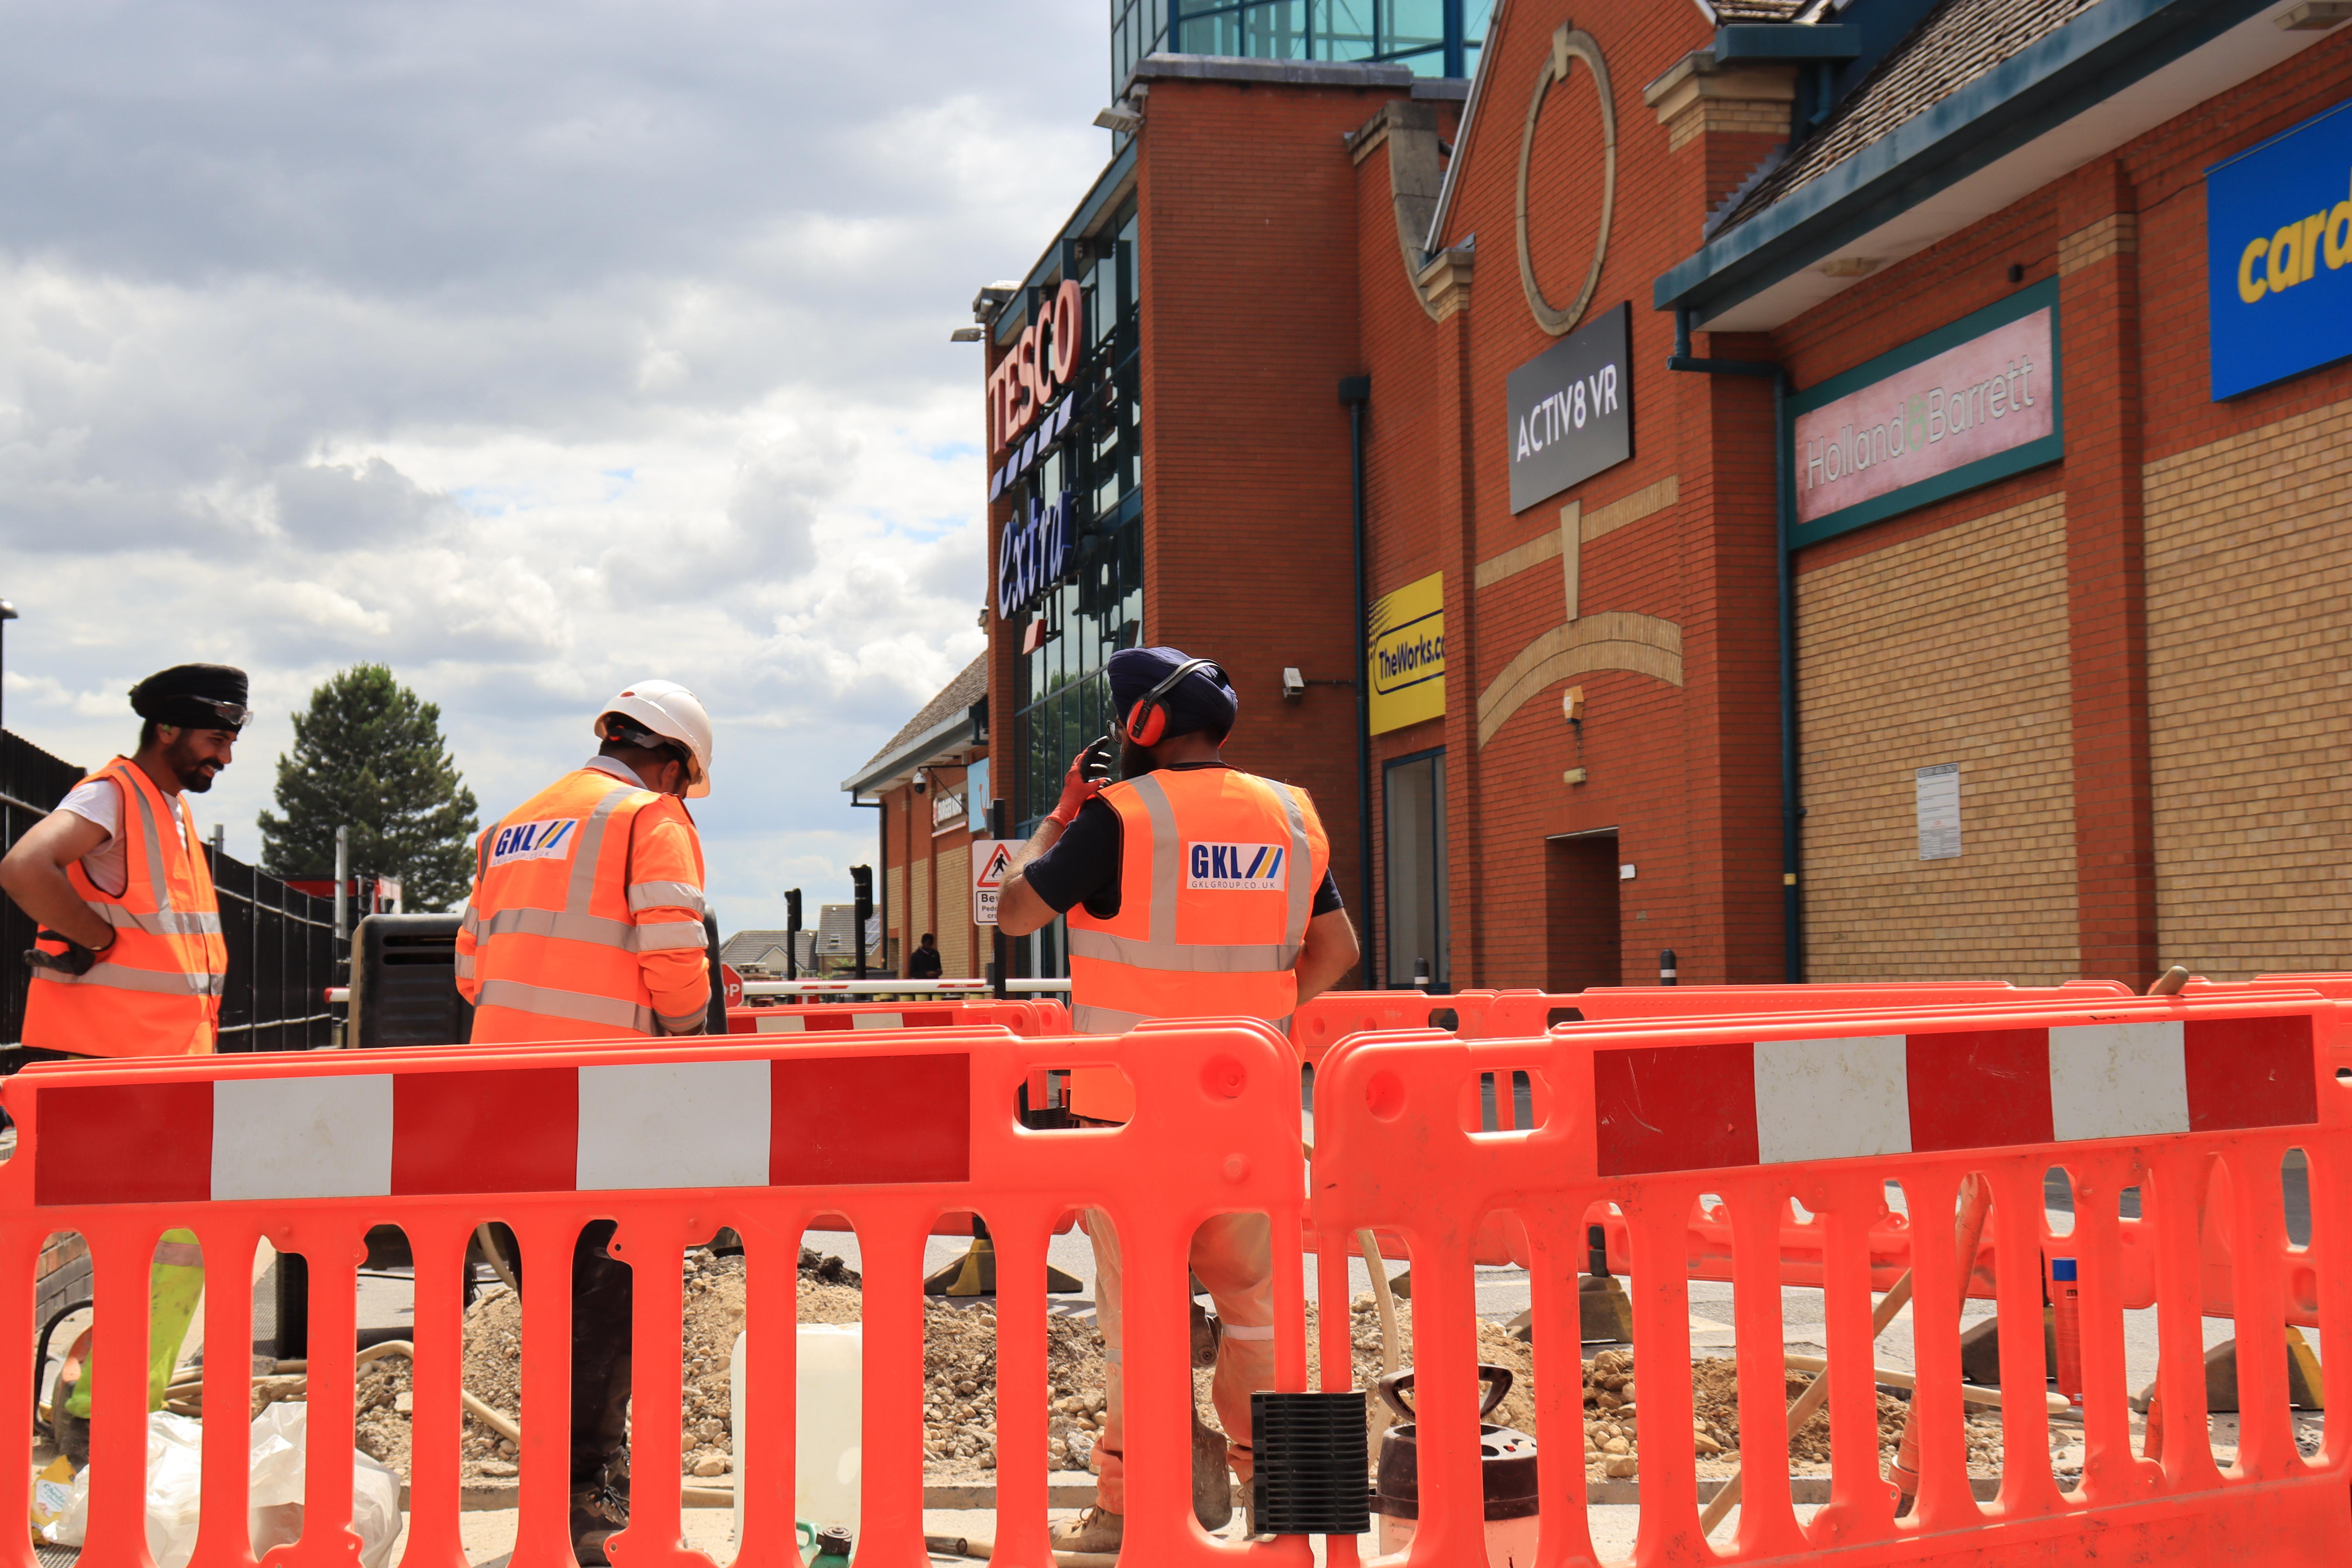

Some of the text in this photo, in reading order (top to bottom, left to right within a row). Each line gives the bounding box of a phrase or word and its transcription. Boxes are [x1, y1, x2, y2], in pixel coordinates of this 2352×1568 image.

[2238, 166, 2352, 303] card
[989, 279, 1081, 454] TESCO
[1516, 364, 1618, 462] ACTIV8 VR
[1808, 355, 2034, 489] Holland & Barrett
[998, 490, 1071, 620] extra
[495, 824, 537, 857] GKL
[1191, 844, 1242, 879] GKL
[1192, 880, 1275, 889] GKLGROUP.CO.UK
